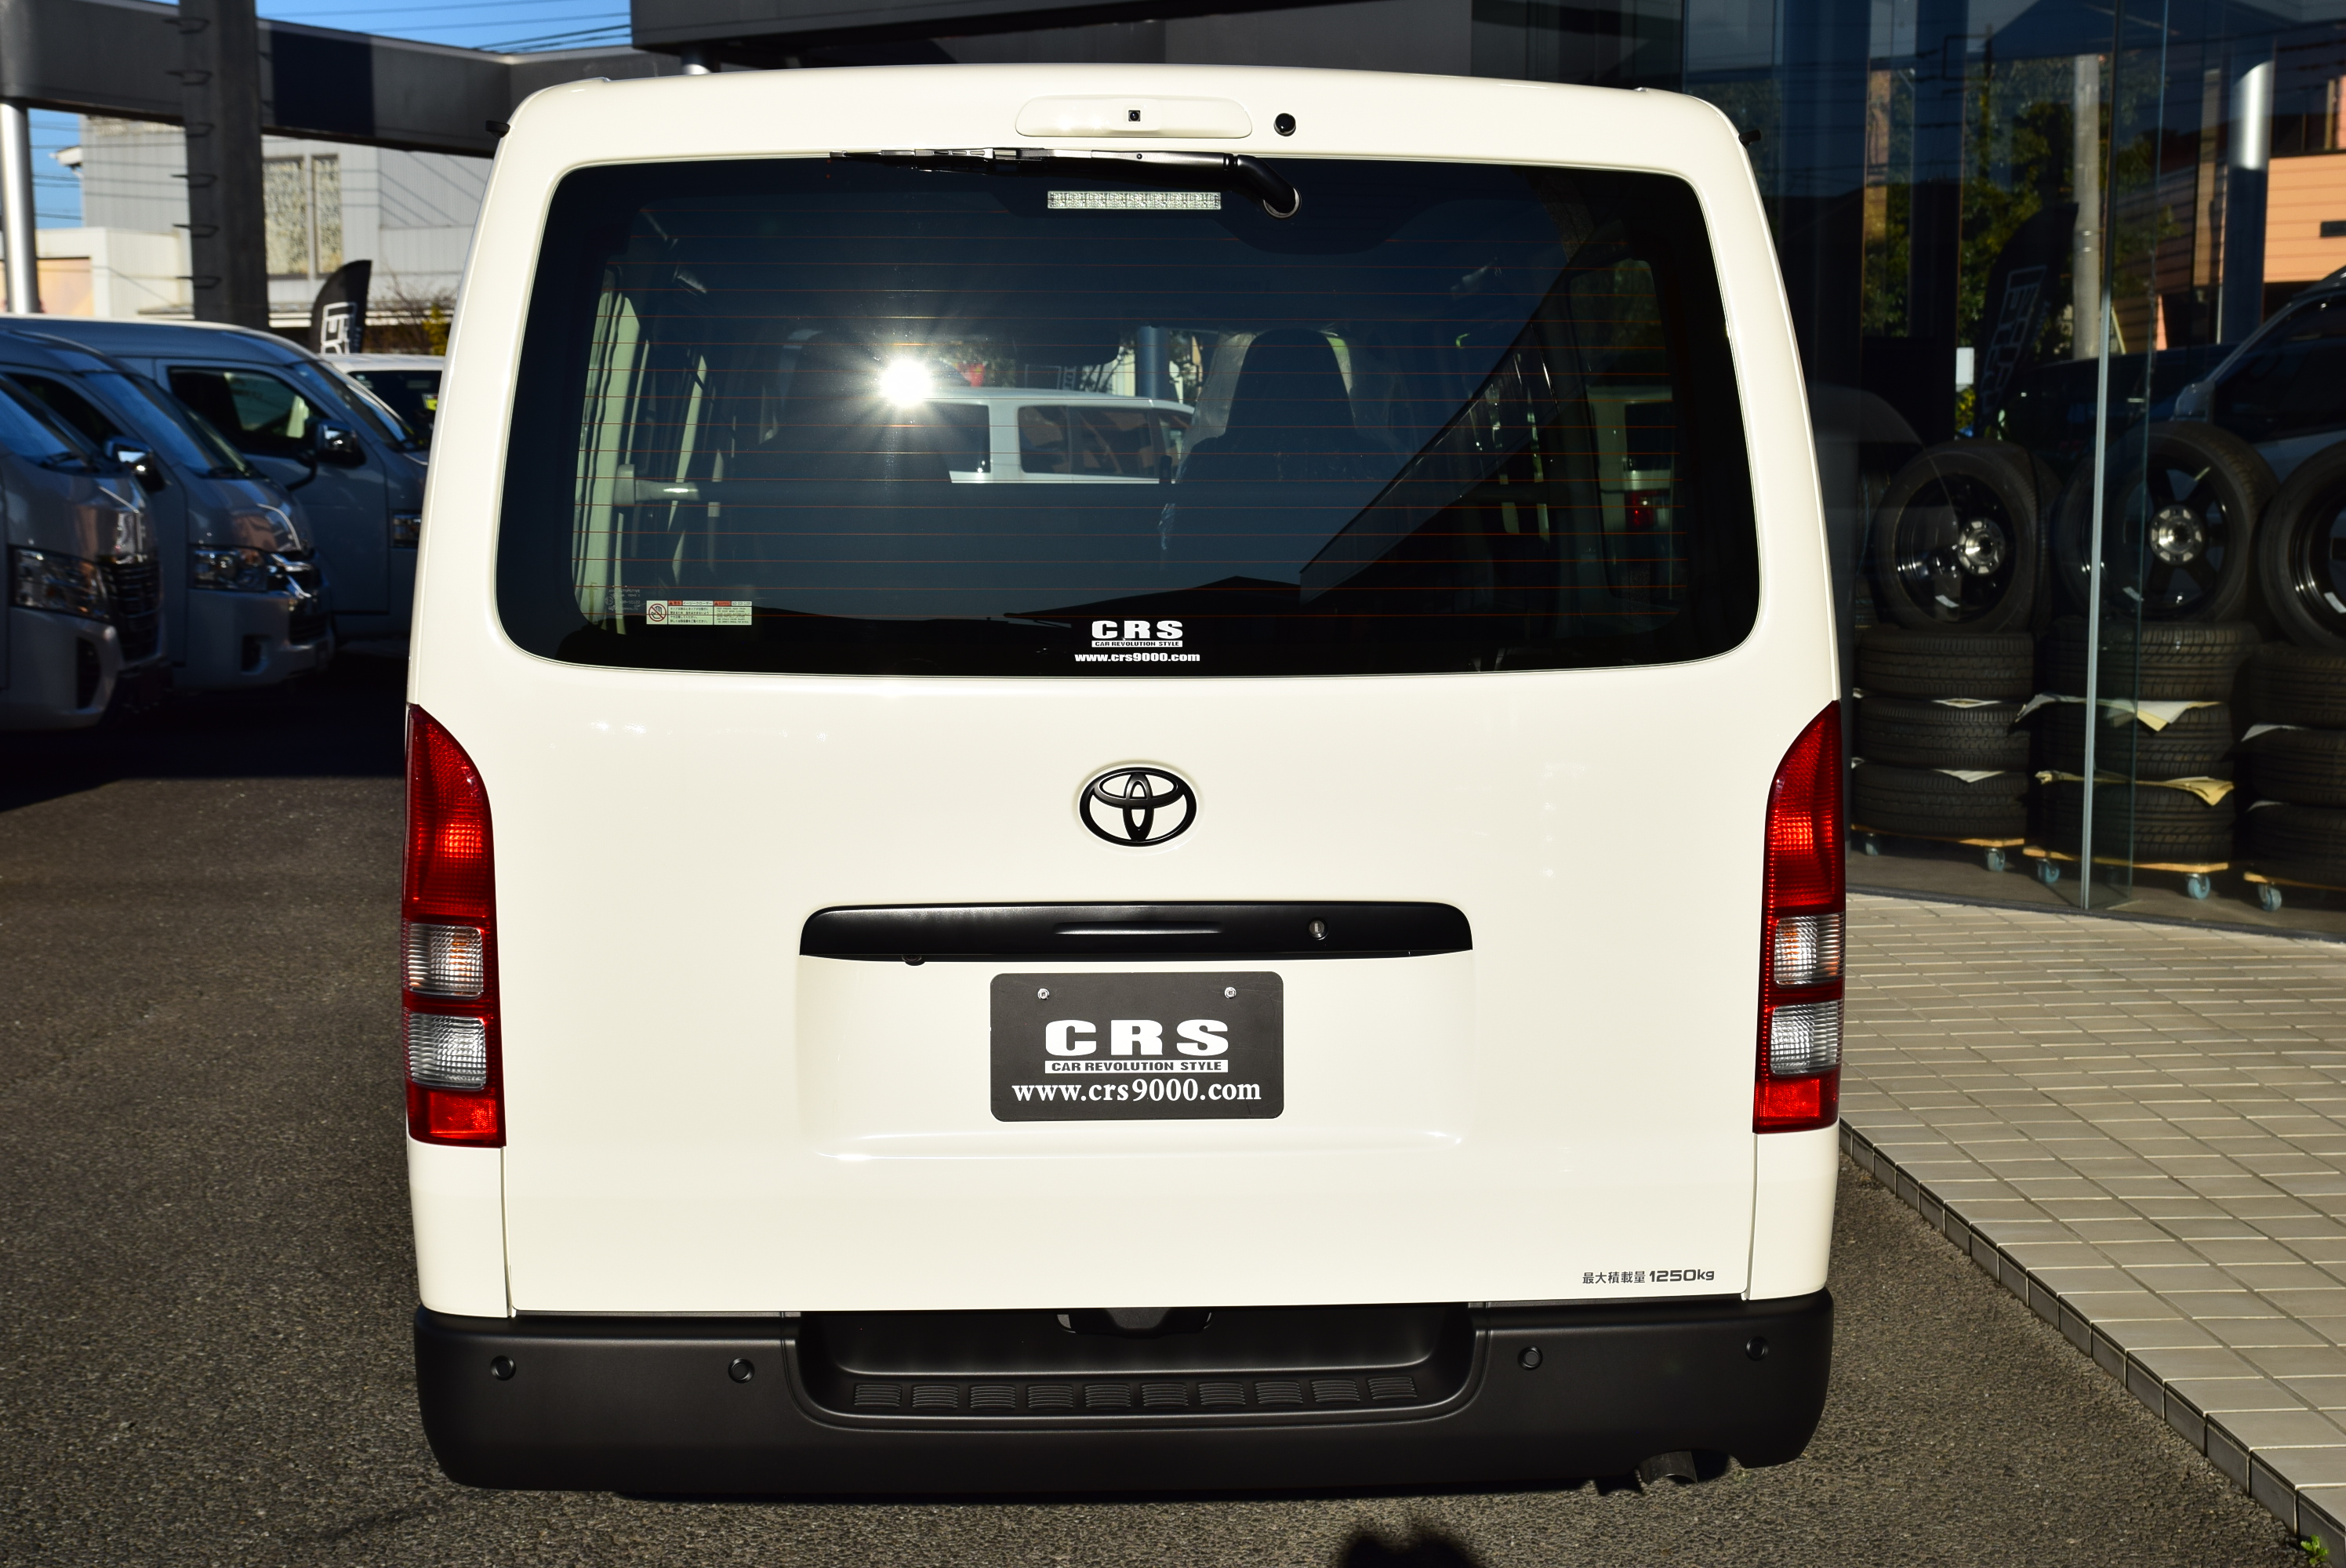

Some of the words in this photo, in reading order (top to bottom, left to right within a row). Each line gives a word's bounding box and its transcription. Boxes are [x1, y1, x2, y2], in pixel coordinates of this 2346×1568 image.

[1091, 620, 1183, 639] CRS
[1074, 652, 1200, 662] www.crs9000.com
[1045, 1019, 1229, 1056] CRS
[1051, 1062, 1081, 1072] CAR
[1084, 1062, 1175, 1072] REVOLUTION
[1179, 1062, 1222, 1071] STYLE
[1011, 1078, 1262, 1102] www.crs9000.com
[1582, 1271, 1646, 1284] 最大積載量
[1649, 1269, 1715, 1283] 1250kg
